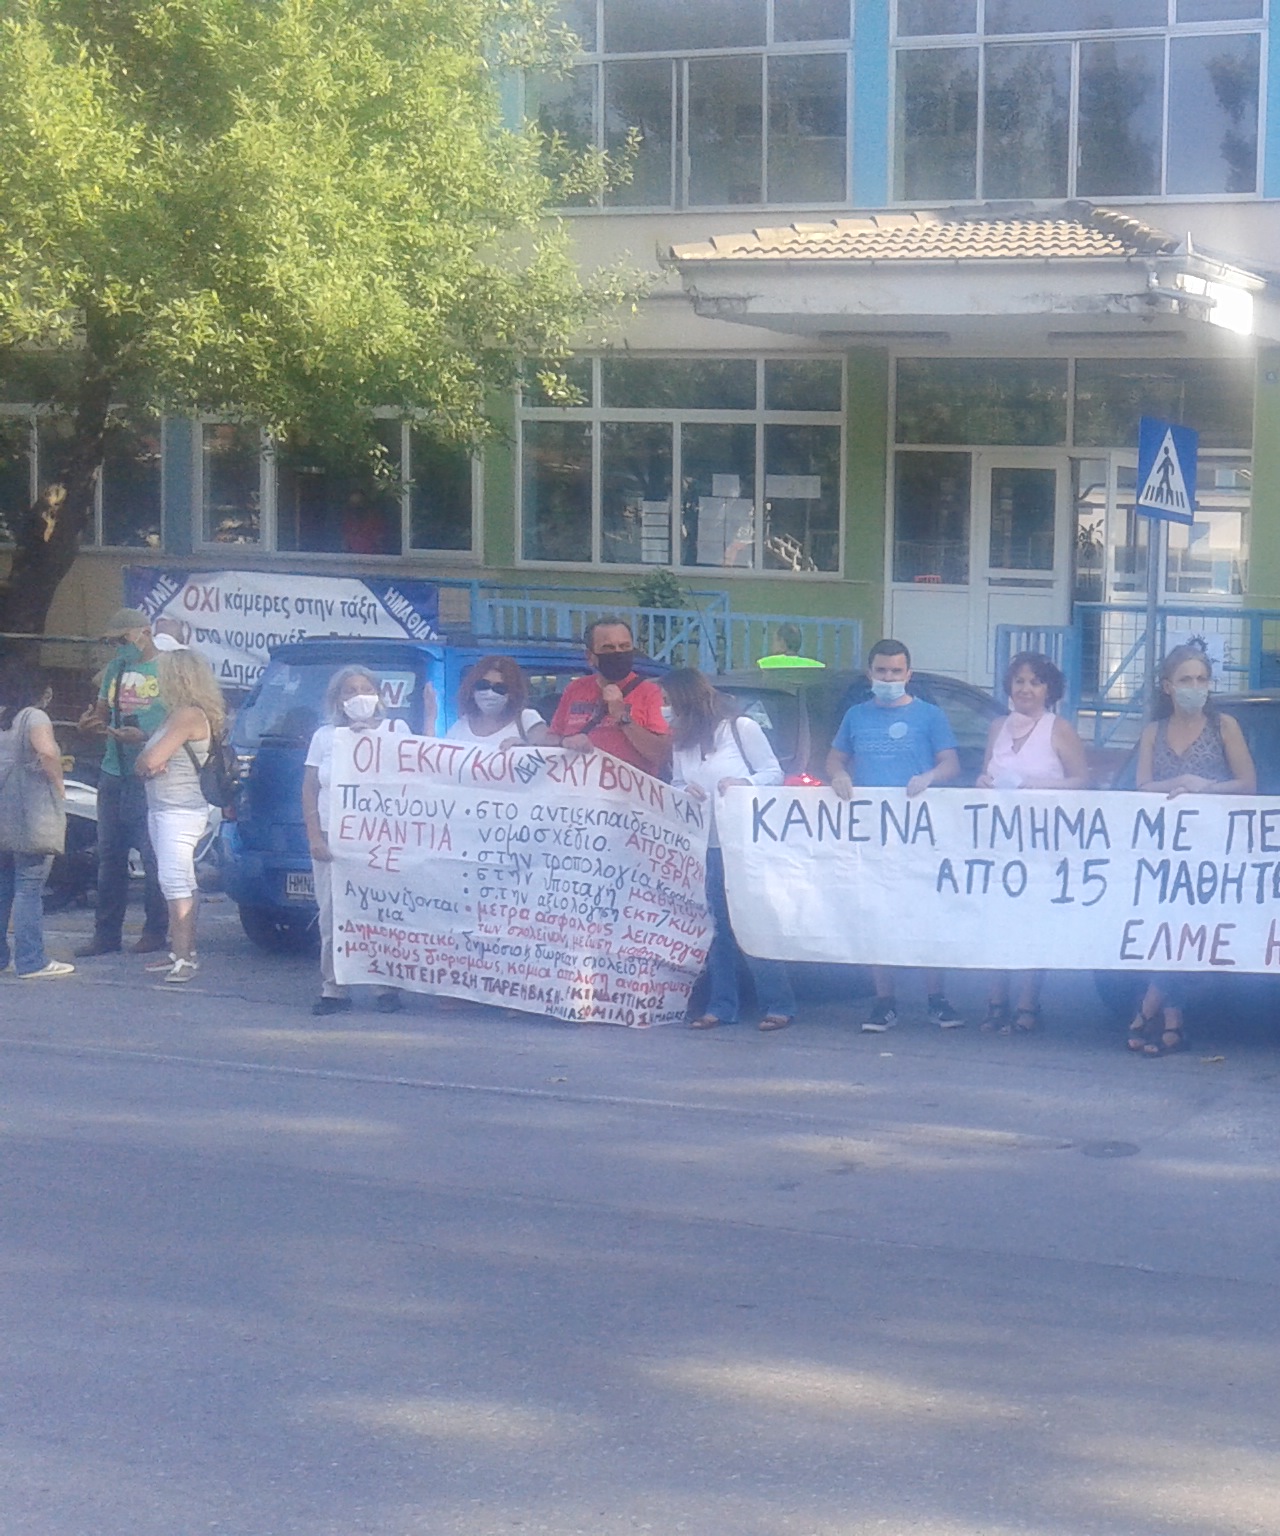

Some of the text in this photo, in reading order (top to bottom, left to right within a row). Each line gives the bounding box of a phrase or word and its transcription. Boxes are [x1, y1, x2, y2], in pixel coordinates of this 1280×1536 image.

[183, 585, 378, 625] ΟΧΙ κάμερες στην τάξη
[195, 627, 222, 645] στο
[353, 736, 381, 773] ΟΙ
[514, 749, 546, 784] ΔΕΝ
[545, 754, 665, 812] ΣΚΥΒΟΥΝ
[671, 792, 704, 830] ΚΑΙ
[337, 784, 456, 820] Παλεύουν
[476, 800, 518, 820] στο
[339, 815, 452, 851] ΕΝΑΝΤΙΑ
[751, 797, 936, 846] ΚΑΝΕΝΑ
[963, 803, 1111, 852] ΤΜΗΜΑ
[1131, 806, 1200, 852] ΜΕ
[367, 845, 404, 873] ΣΕ
[476, 867, 533, 886] στην
[477, 850, 652, 890] στην τροπολογία
[345, 880, 459, 913] Αγωνίζονται
[936, 857, 1028, 899] ΑΠΟ
[1050, 857, 1112, 907] 15
[378, 907, 404, 922] για
[1119, 918, 1237, 966] ΕΛΜΕ
